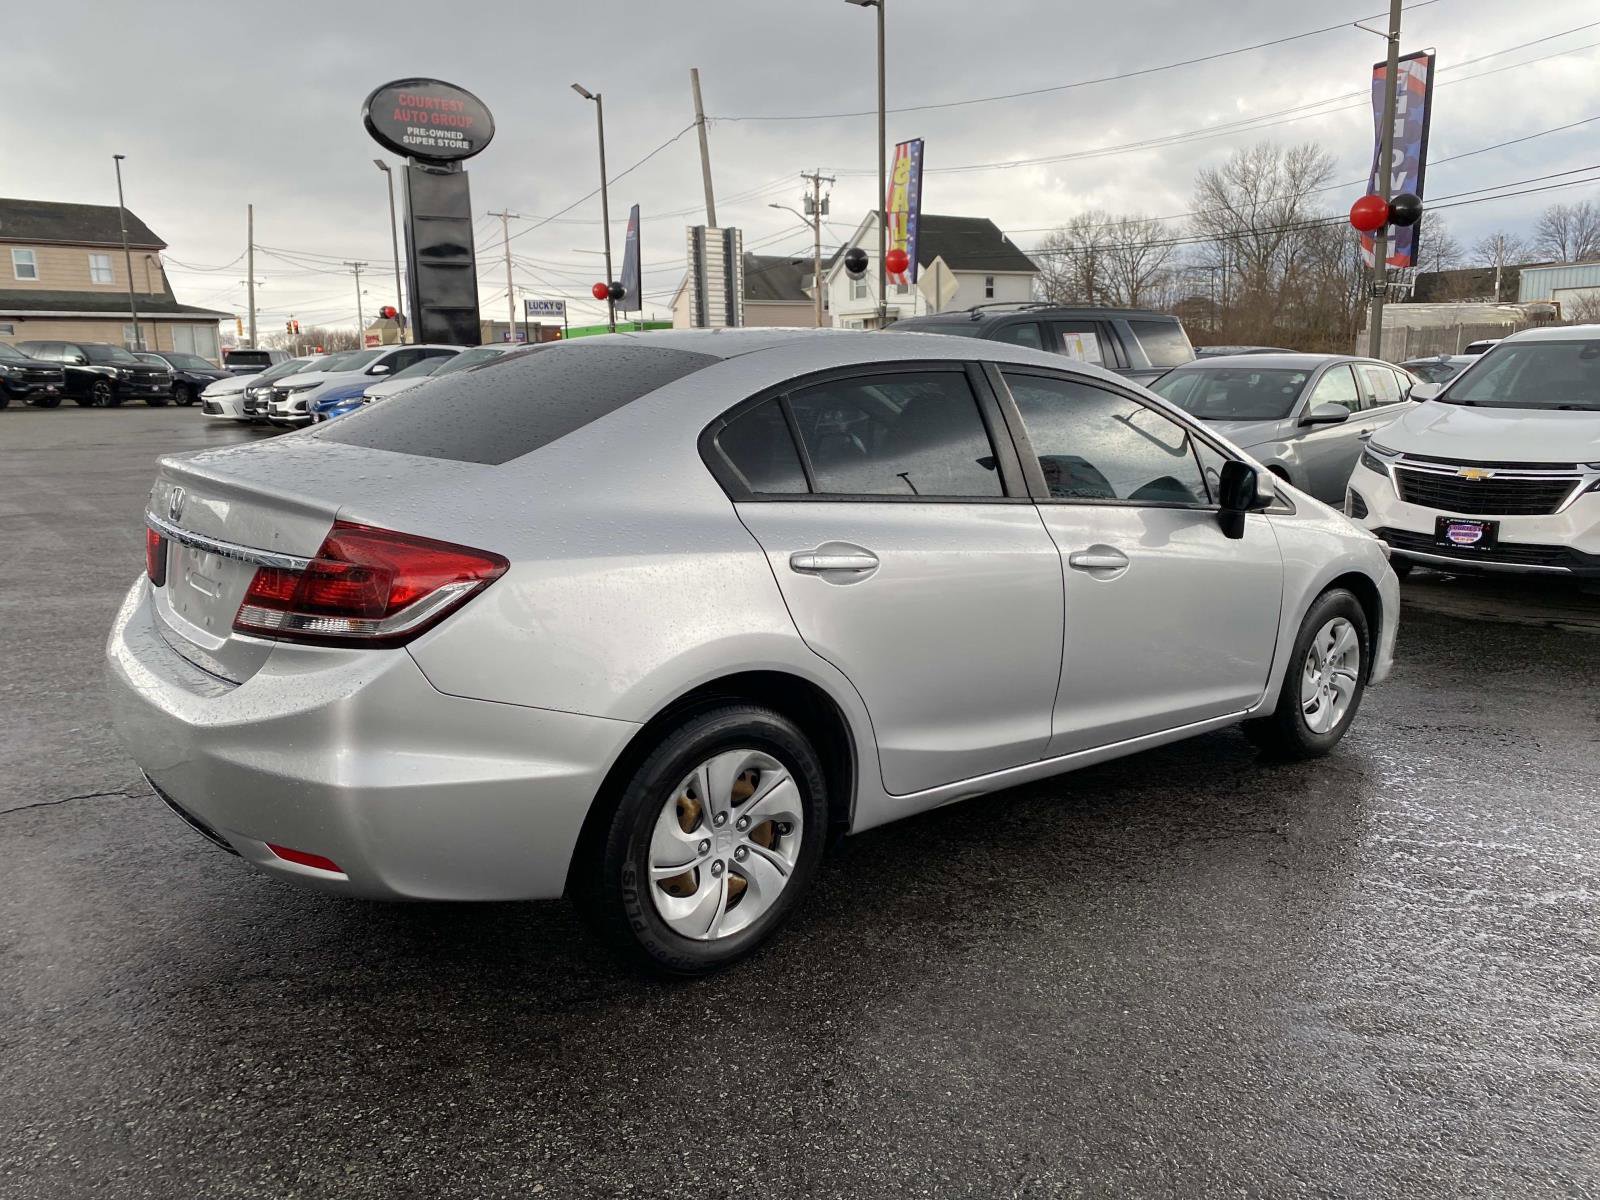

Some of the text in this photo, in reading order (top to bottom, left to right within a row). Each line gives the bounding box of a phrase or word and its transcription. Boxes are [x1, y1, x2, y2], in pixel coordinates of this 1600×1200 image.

[398, 94, 465, 112] COURTESY
[393, 107, 473, 128] AUTO GROUP
[407, 126, 463, 140] PRE-OWNED
[402, 135, 470, 149] SUPER STORE
[528, 301, 554, 310] LUCKY
